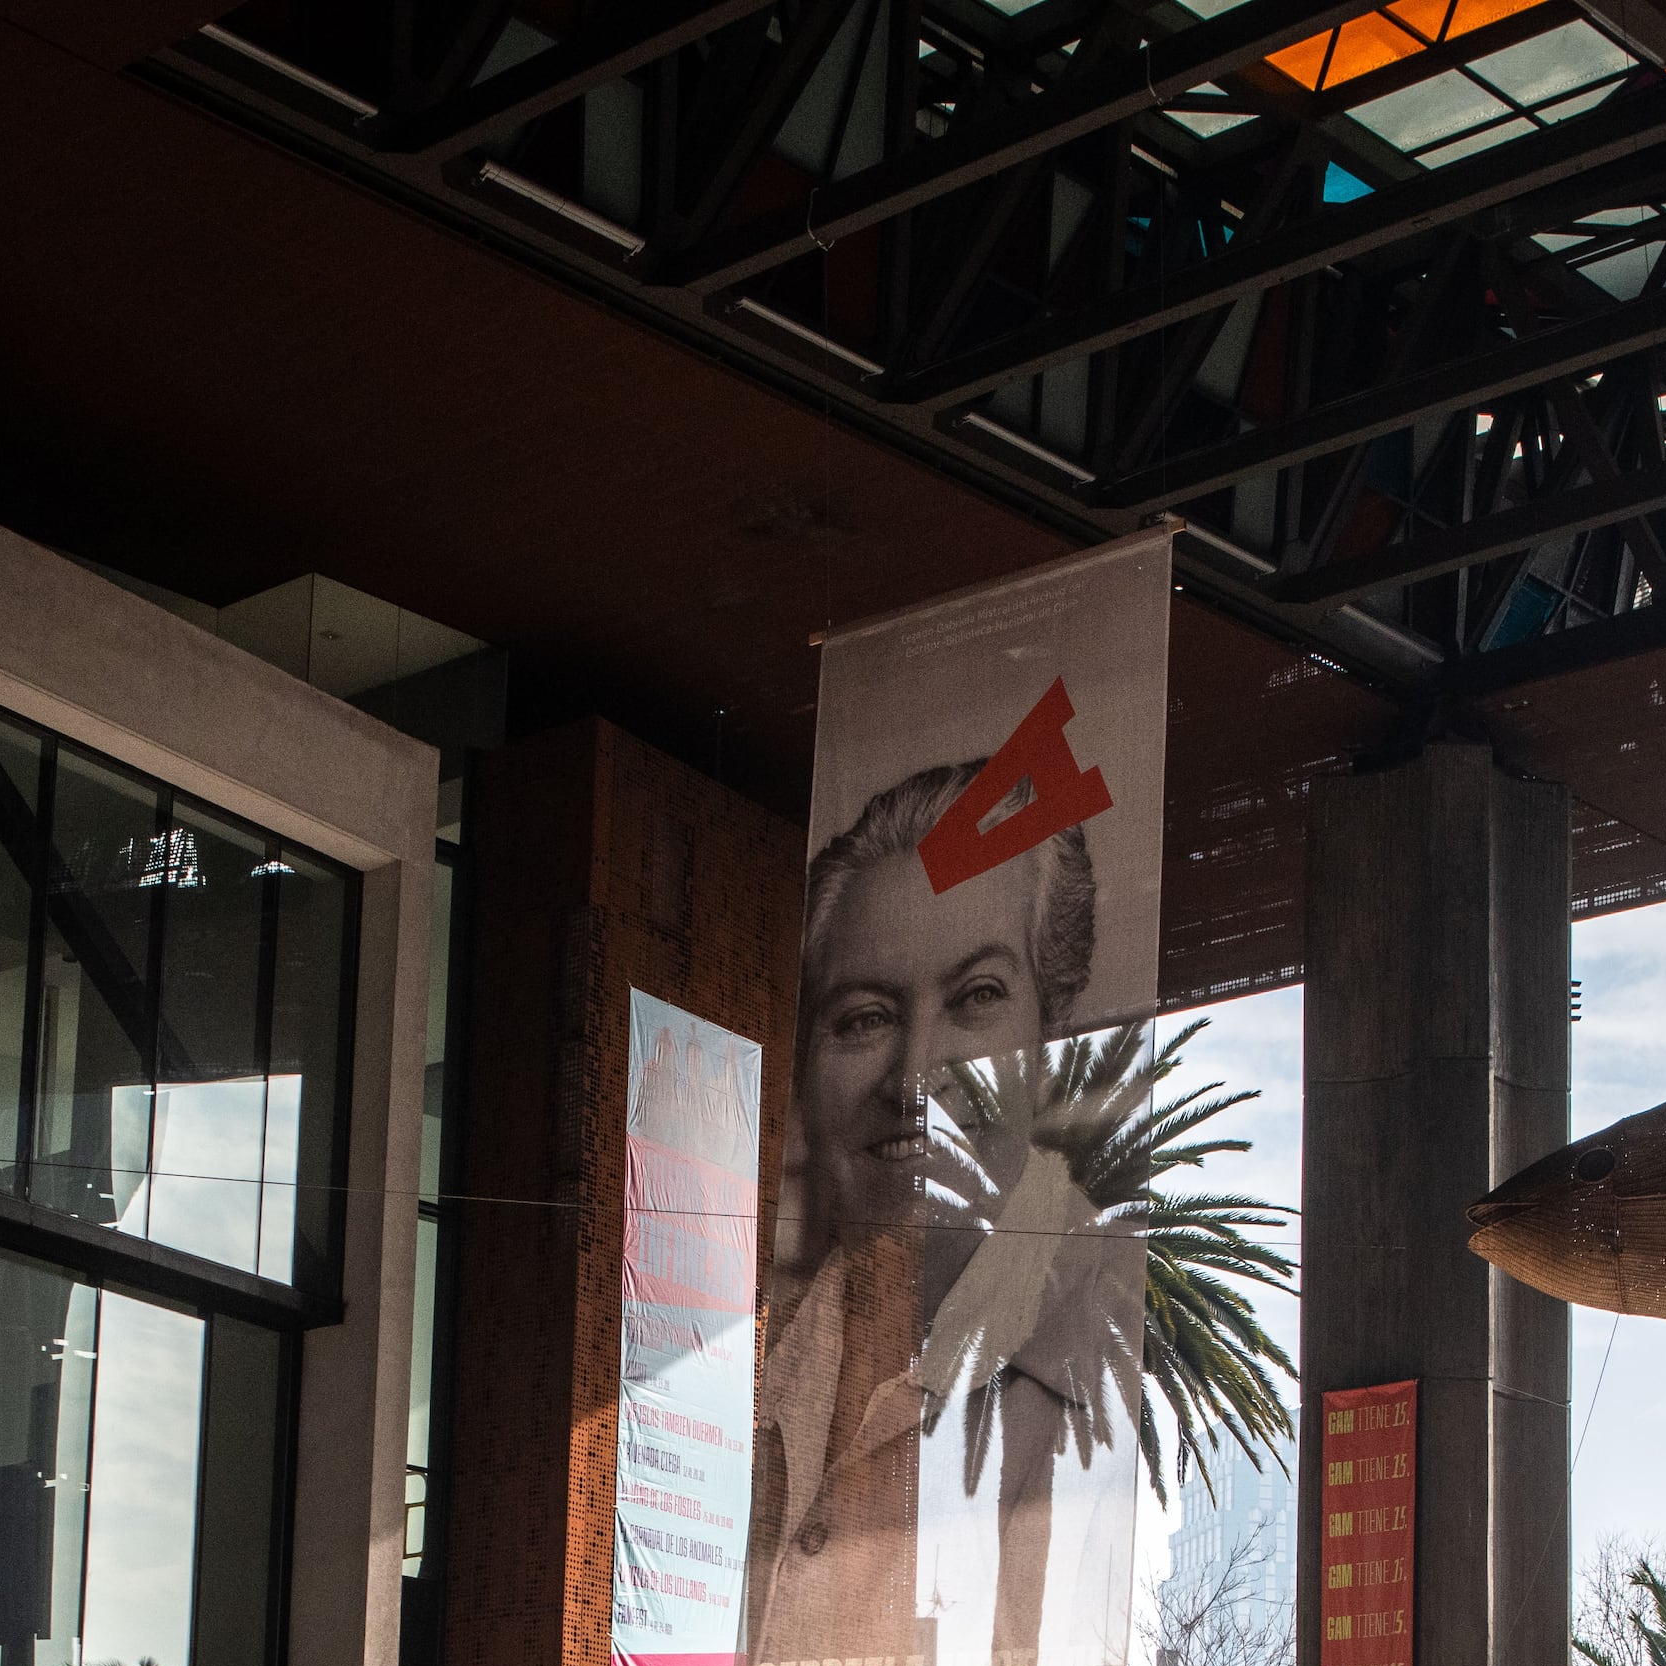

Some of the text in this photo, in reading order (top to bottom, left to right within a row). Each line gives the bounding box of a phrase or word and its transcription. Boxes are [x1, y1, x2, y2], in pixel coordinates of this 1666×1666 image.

[936, 614, 975, 633] Gabriela
[977, 602, 1011, 620] Mistral
[995, 614, 1035, 632] Nacional
[917, 675, 1114, 895] A
[638, 1404, 659, 1428] ISLAS
[661, 1410, 691, 1438] TAMBIEN
[693, 1419, 724, 1448] DUERMEN
[1328, 1401, 1410, 1435] GAM TIENE 15.
[631, 1443, 659, 1469] VENADA
[660, 1450, 681, 1475] CIEGA
[1328, 1454, 1410, 1486] GAM TIENE 15.
[631, 1482, 649, 1507] NIÑO
[650, 1488, 660, 1510] DE
[660, 1490, 673, 1514] LOS
[674, 1495, 702, 1520] FOSILES
[1329, 1505, 1408, 1537] GAM TIENE 15.
[629, 1524, 664, 1553] CARNAVAL
[665, 1532, 675, 1554] DE
[675, 1535, 688, 1558] LOS
[689, 1538, 723, 1567] ANIMALES
[650, 1569, 660, 1590] DE
[660, 1572, 673, 1595] LOS
[674, 1575, 707, 1603] VILLANOS
[1328, 1564, 1352, 1589] GAM
[1356, 1560, 1389, 1586] TIENE
[1327, 1616, 1352, 1641] GAM
[1355, 1612, 1390, 1638] TIENE
